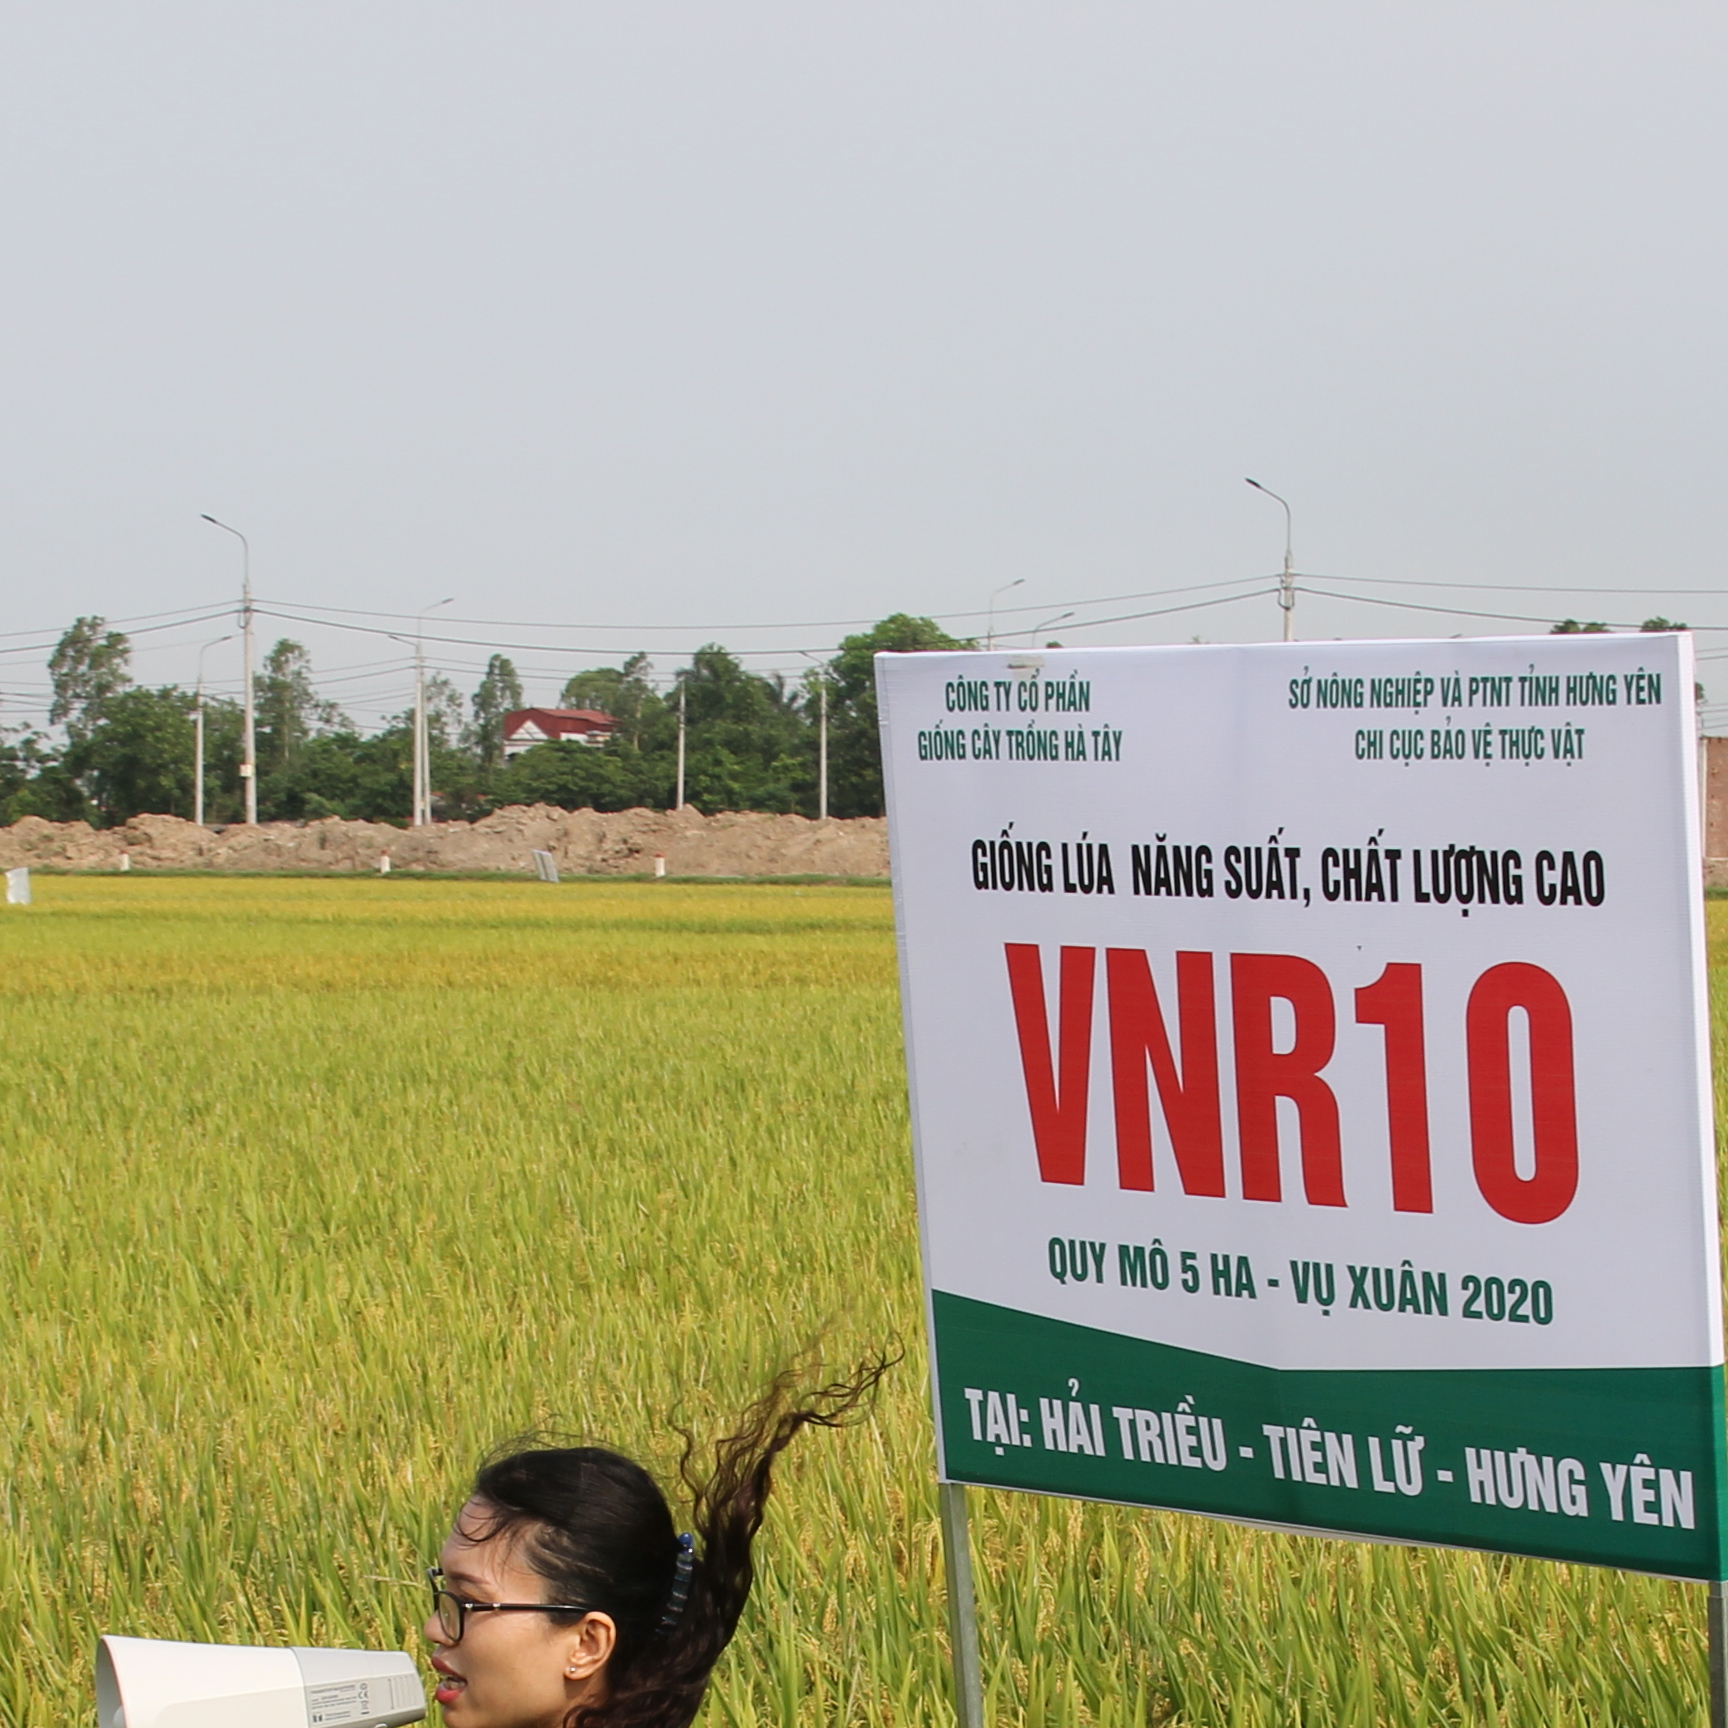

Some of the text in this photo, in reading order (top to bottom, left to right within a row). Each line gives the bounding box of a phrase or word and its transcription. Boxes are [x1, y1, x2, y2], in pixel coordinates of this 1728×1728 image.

[946, 675, 989, 712] CÔNG
[994, 681, 1011, 712] TY
[1017, 668, 1040, 712] CỔ
[1289, 664, 1661, 715] SỞ NÔNG NGHIỆP VÀ PTNT TỈNH HƯNG YÊN
[918, 719, 966, 760] GIỐNG
[972, 723, 1001, 760] CÂY
[1065, 724, 1086, 761] HÀ
[1092, 724, 1122, 761] TÂY
[1356, 716, 1584, 767] CHI CỤC BẢO VỆ THỰC VẬT
[972, 822, 1605, 917] GIỐNG LÚA NĂNG SUẤT, CHẤT LƯỢNG CAO
[1004, 943, 1579, 1224] VNR10
[1048, 1237, 1554, 1325] QUY MÔ 5 HA - VỤ XUÂN 2020
[965, 1378, 1695, 1530] TẠI: HẢI TRIỀU - TIÊN LỮ - HƯNG YÊN
